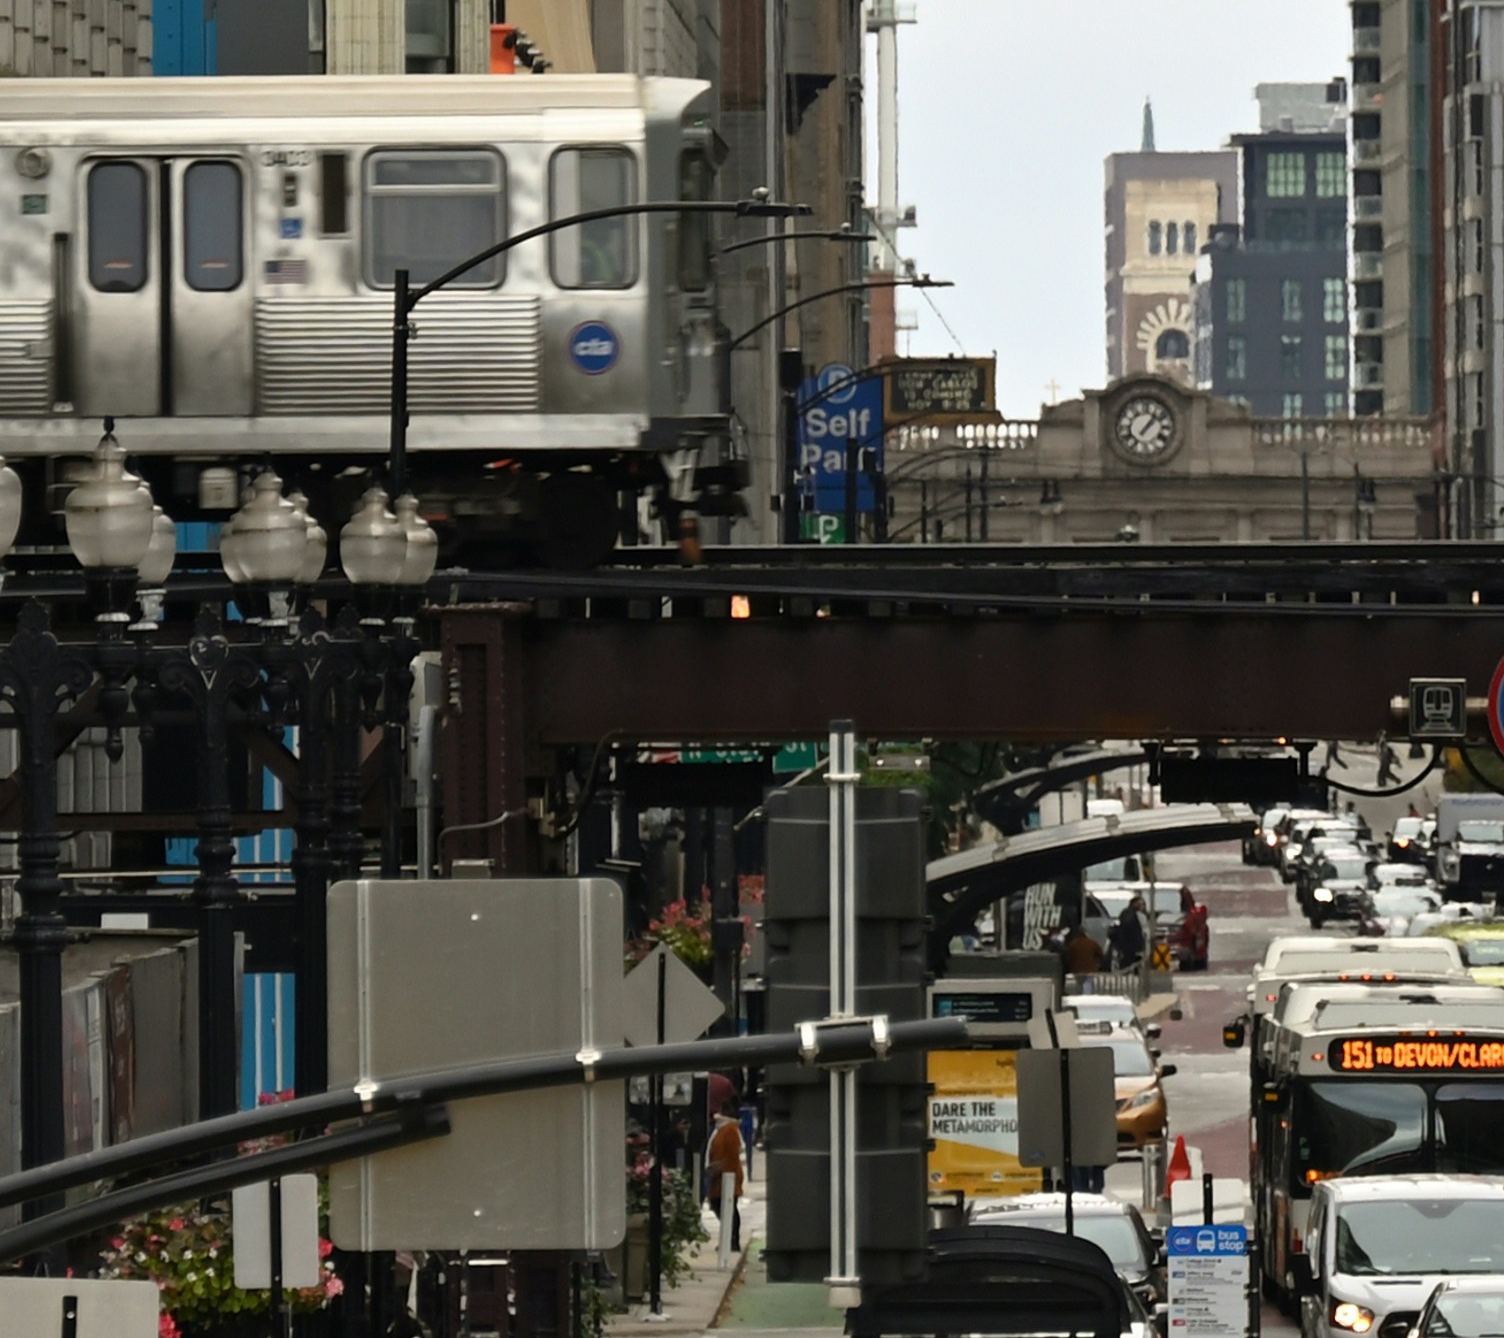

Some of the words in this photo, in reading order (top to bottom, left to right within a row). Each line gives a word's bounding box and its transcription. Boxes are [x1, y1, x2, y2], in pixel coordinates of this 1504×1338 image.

[805, 407, 870, 438] Self
[1023, 926, 1042, 950] US
[1342, 1040, 1375, 1070] 151
[932, 1102, 967, 1118] DARE
[971, 1101, 996, 1117] THE
[1218, 1229, 1239, 1240] bus
[1218, 1241, 1244, 1253] stop
